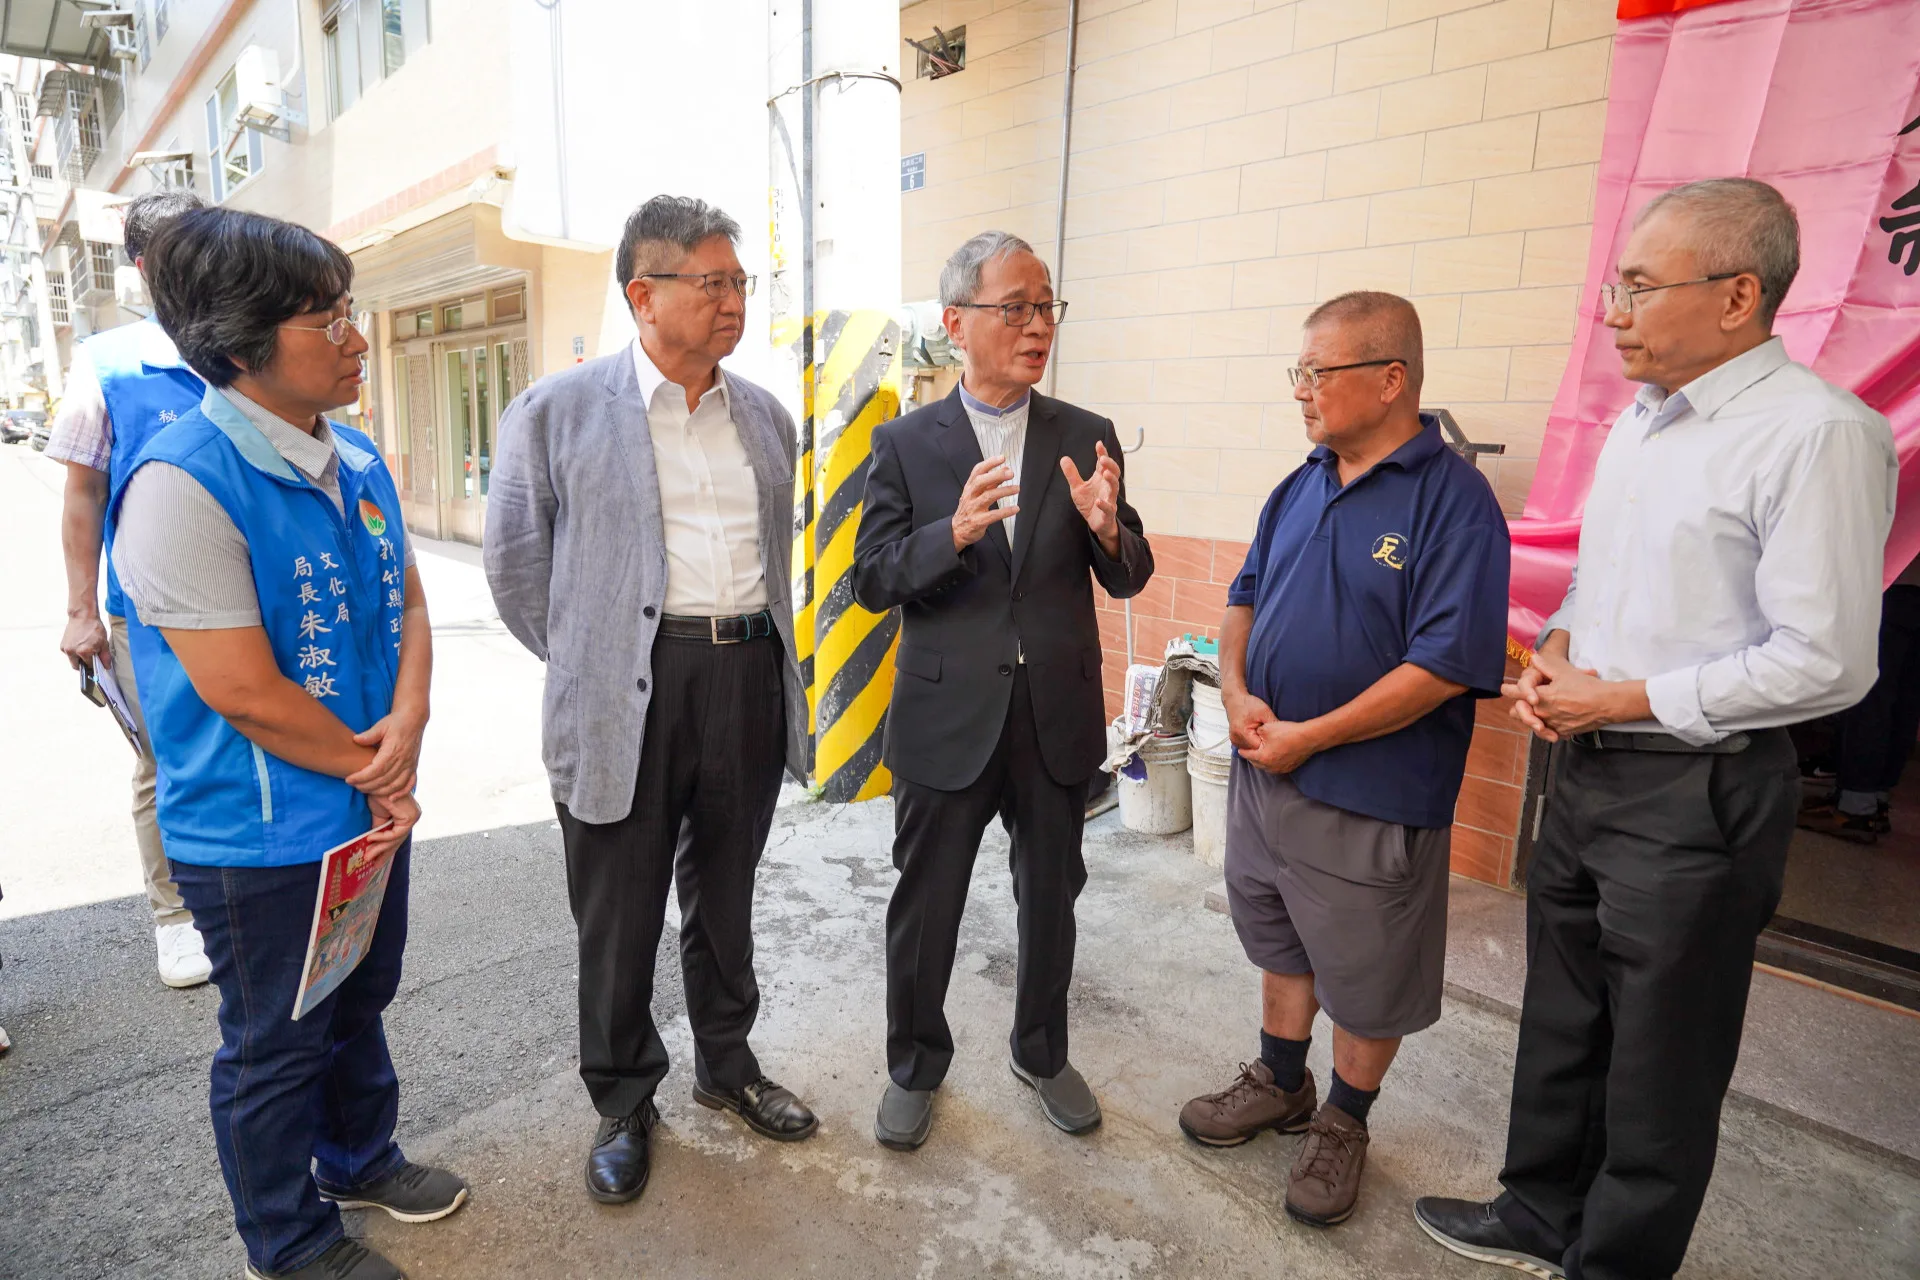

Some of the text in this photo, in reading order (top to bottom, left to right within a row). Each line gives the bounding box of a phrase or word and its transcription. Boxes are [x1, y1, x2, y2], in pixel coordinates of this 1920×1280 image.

[910, 174, 915, 189] 6
[319, 551, 349, 624] 文化局
